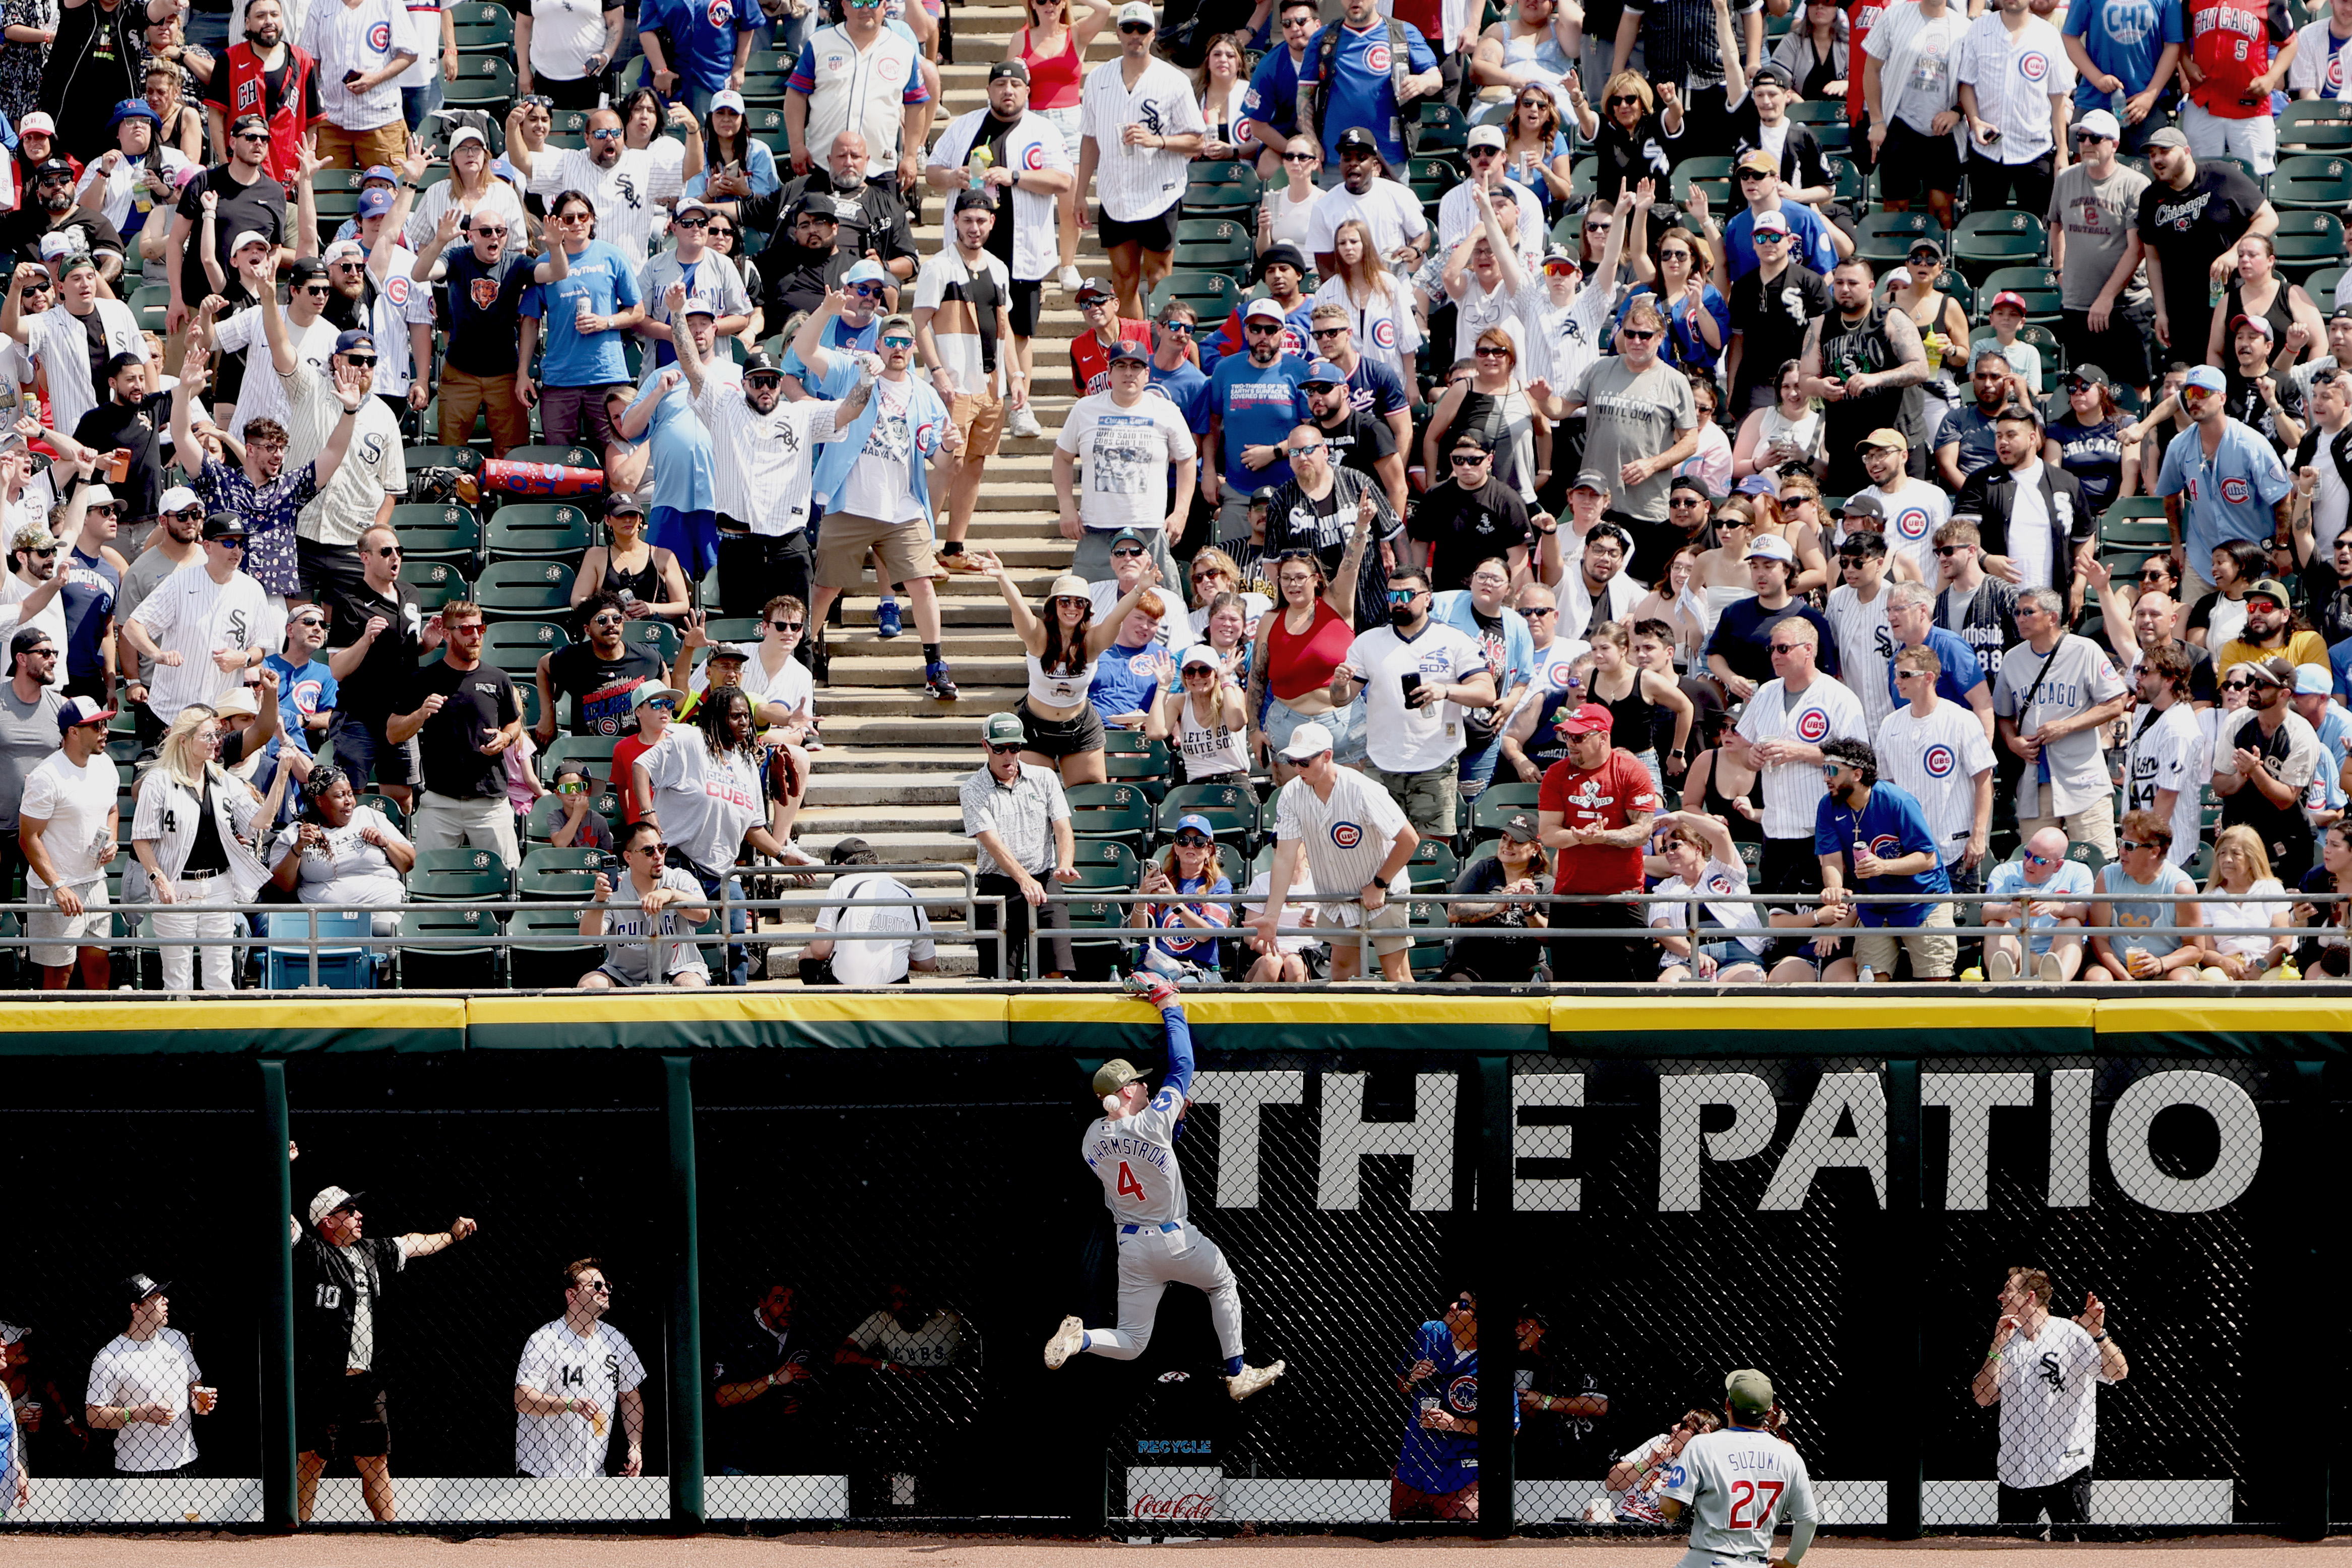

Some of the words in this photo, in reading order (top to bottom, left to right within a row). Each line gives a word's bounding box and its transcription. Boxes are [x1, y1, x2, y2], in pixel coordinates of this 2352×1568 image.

[2194, 8, 2260, 42] CHICAGO
[2235, 40, 2249, 61] 5
[484, 61, 496, 70] 16
[768, 116, 779, 124] 19
[2331, 165, 2341, 173] 12
[2155, 192, 2210, 226] Chicago
[389, 281, 408, 302] CUBS
[1084, 277, 1096, 289] S
[560, 290, 584, 299] American
[1822, 334, 1885, 368] CHICAGO
[2189, 479, 2198, 501] 4
[1903, 512, 1924, 534] CUBS
[648, 628, 659, 636] 17
[1419, 664, 1449, 673] SOX
[1976, 650, 2002, 672] 88
[603, 675, 646, 700] CHAMPIONS
[1216, 725, 1228, 736] GO
[1801, 712, 1824, 738] CUBS
[1183, 729, 1212, 743] LET'S
[1216, 735, 1235, 749] SOX
[1928, 749, 1950, 773] CUBS
[706, 780, 753, 811] CUBS
[1595, 797, 1612, 807] SIDE
[1187, 815, 1198, 823] C
[1336, 826, 1358, 846] CUBS
[1419, 905, 1426, 913] 4
[857, 910, 911, 932] SECURITY
[1192, 1071, 1585, 1211] THE
[1659, 1068, 2262, 1213] PATIO
[1117, 1160, 1148, 1202] 4
[316, 1283, 340, 1309] 10
[562, 1364, 584, 1387] 14
[1138, 1440, 1211, 1454] RECYCLE
[1728, 1451, 1781, 1472] SUZUKI
[1134, 1493, 1215, 1519] Coca-Cola
[1729, 1480, 1785, 1530] 27
